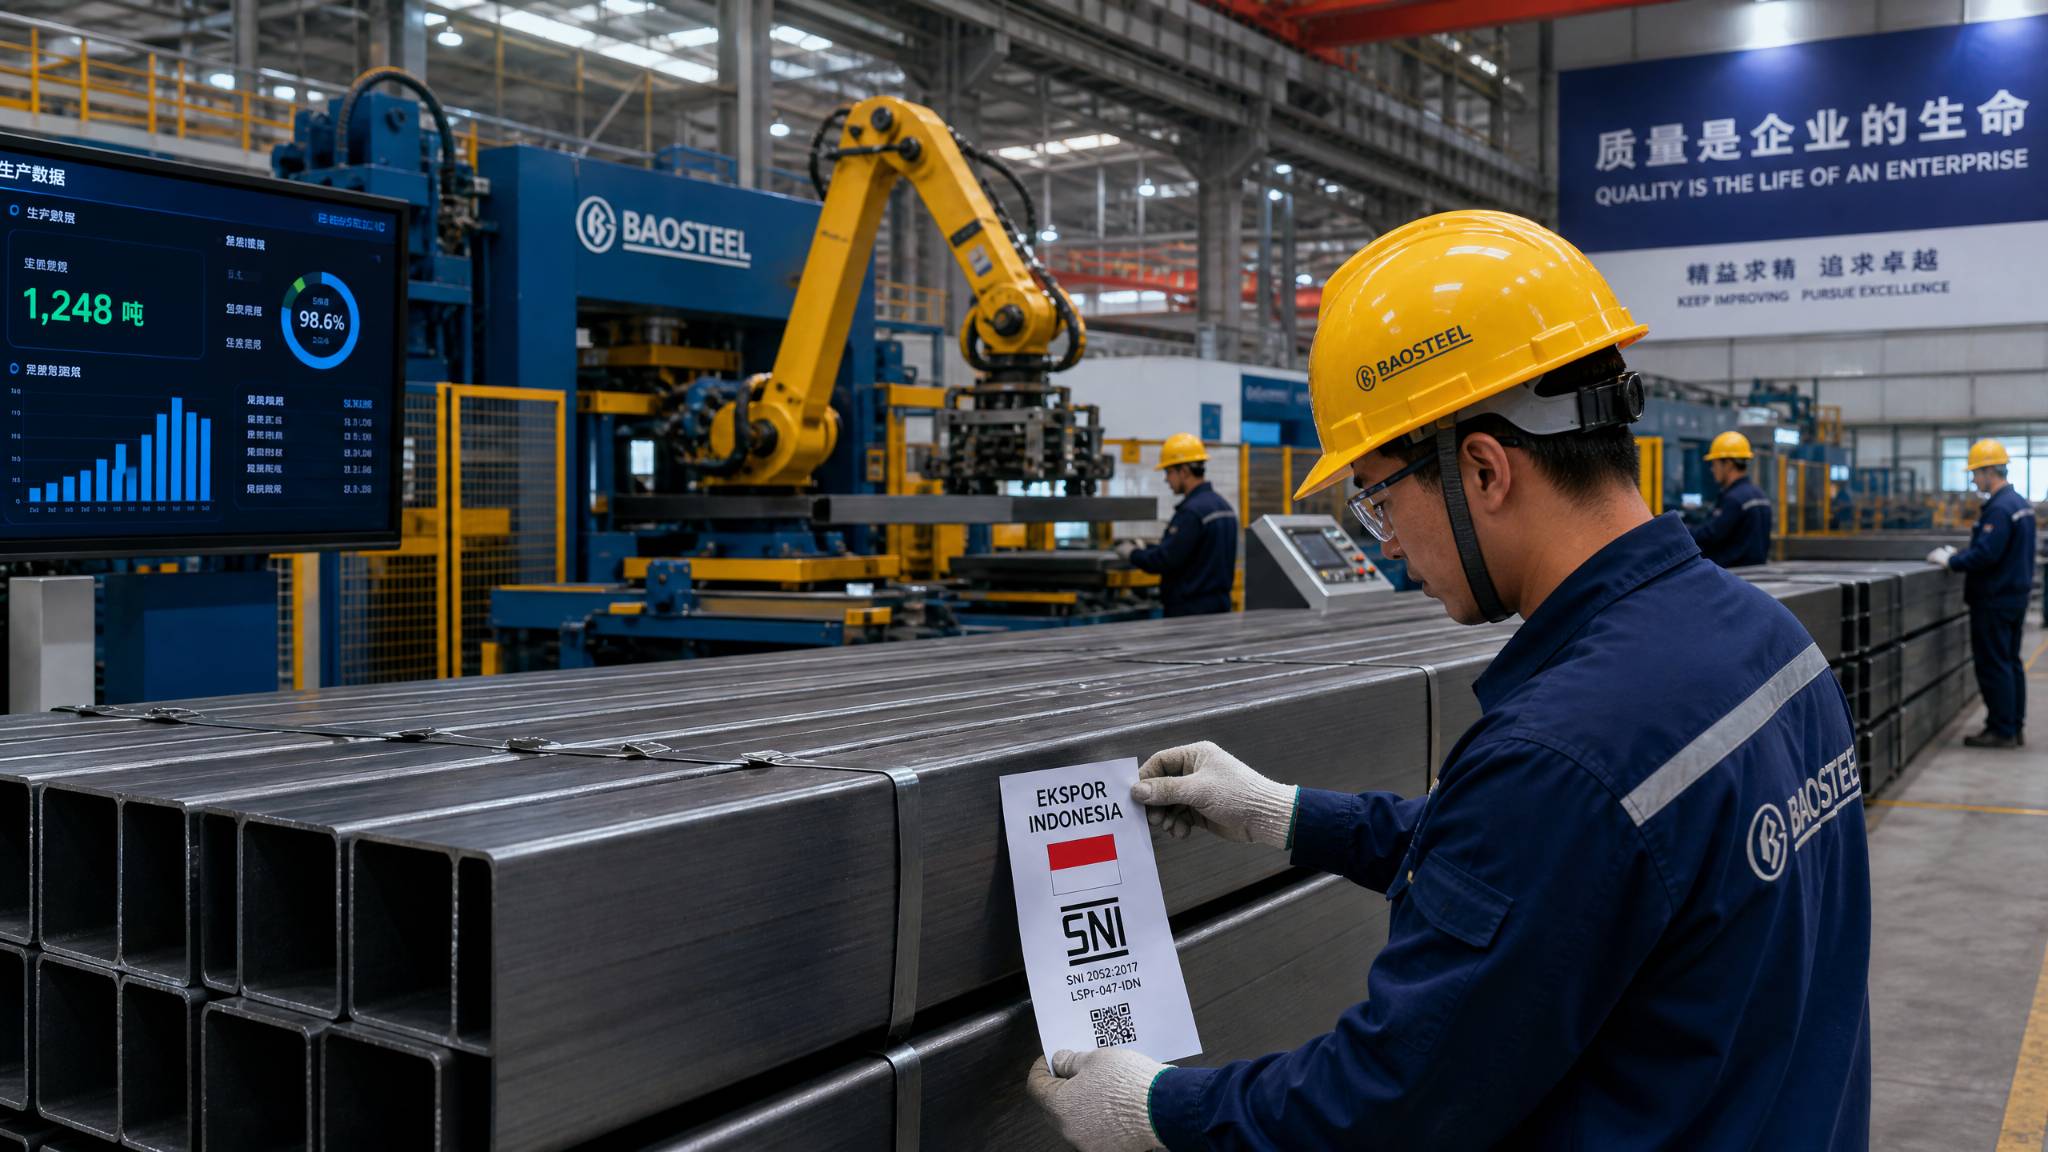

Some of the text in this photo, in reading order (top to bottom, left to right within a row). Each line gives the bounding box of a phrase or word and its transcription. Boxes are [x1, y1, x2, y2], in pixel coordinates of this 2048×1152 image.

[1595, 88, 2030, 172] 质量是企业的生命
[0, 160, 66, 187] 生产数据
[1595, 148, 2029, 206] QUALITY IS THE LIFE OF AN ENTERPRISE
[622, 210, 752, 261] BAOSTEEL
[1686, 249, 1939, 286] 精益求精 追求卓越
[24, 287, 144, 327] 1,248 吨
[1677, 280, 1951, 308] KEEP IMPROVING PURSUE EXCELLENCE
[299, 310, 345, 331] 98.6%
[1376, 324, 1472, 377] BAOSTEEL
[1036, 780, 1108, 808] EKSPOR
[1787, 744, 1861, 839] BAOSTEE
[1028, 802, 1124, 834] INDONESIA
[1062, 905, 1128, 957] SNI
[1066, 962, 1139, 986] SNI 2052:2017
[1070, 978, 1142, 1002] LSPr-047-IDN
